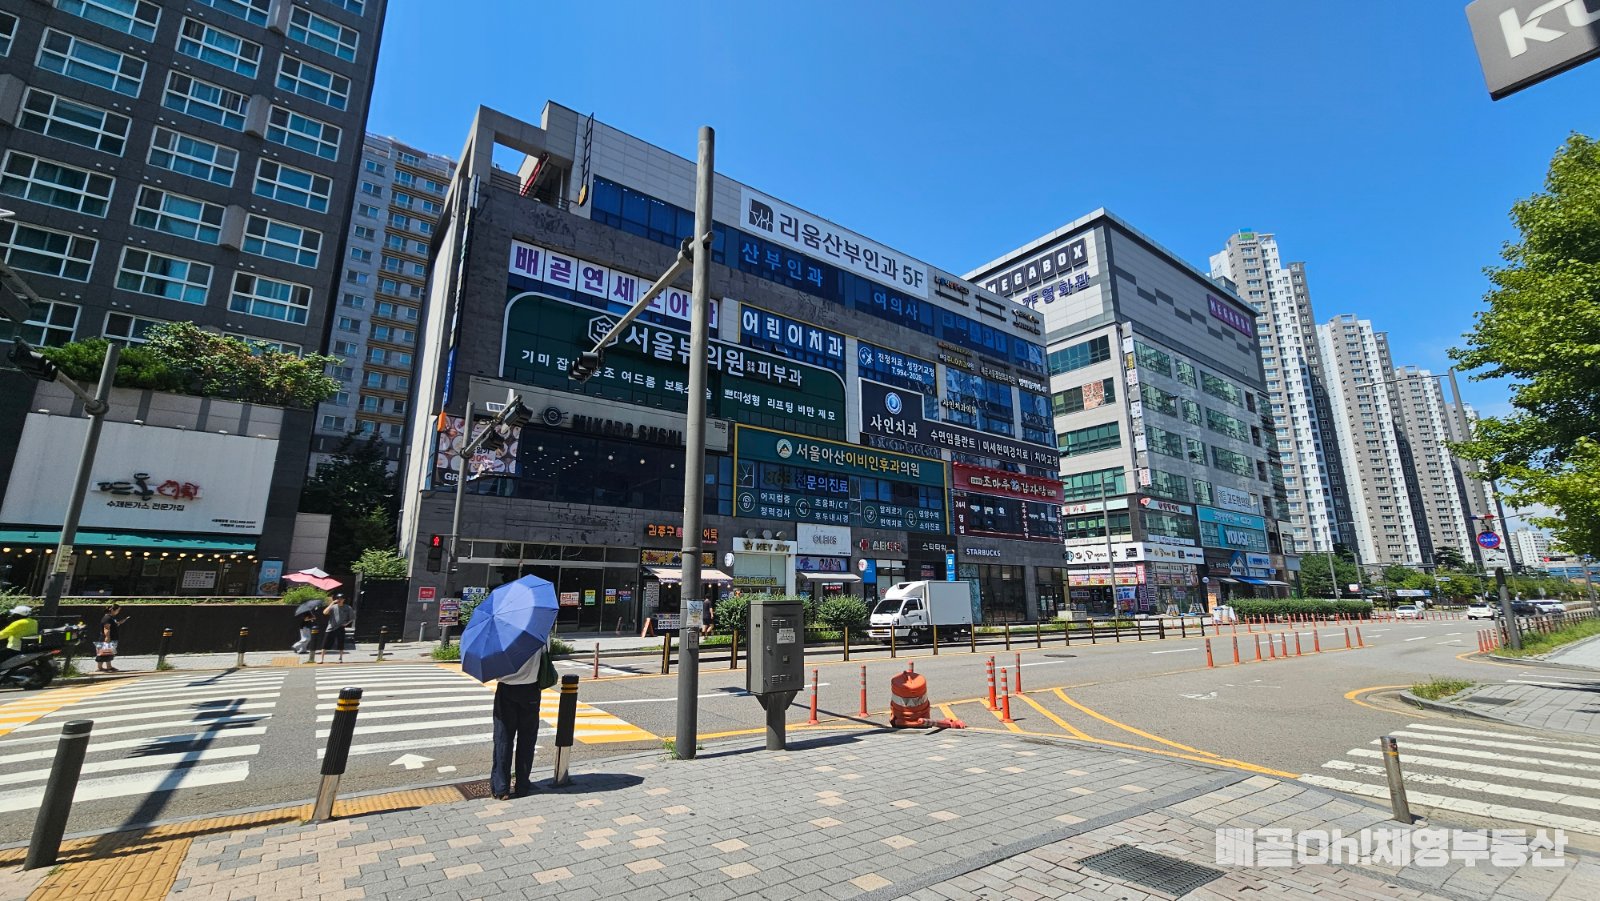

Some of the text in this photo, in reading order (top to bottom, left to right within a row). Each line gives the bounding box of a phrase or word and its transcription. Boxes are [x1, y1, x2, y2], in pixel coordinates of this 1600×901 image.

[742, 241, 823, 287] 산부인과
[779, 212, 898, 280] 리움산부인과
[902, 264, 924, 288] 5F
[515, 245, 716, 324] 배곧연세아
[987, 244, 1083, 293] MEGABOX
[873, 291, 918, 321] 여의사
[742, 310, 843, 357] 어린이치과
[522, 350, 550, 367] 기미
[621, 371, 656, 388] 여드름
[724, 389, 760, 407] 쁘띠성형
[767, 398, 794, 413] 리프팅
[797, 404, 815, 418] 비만
[818, 409, 836, 421] 제모
[757, 361, 803, 387] 피부과
[572, 414, 683, 446] MIKADO SUSHI
[870, 414, 918, 439] 샤인치과
[930, 430, 976, 450] 수면임플란트
[796, 443, 920, 478] 서울아산이비인후과의원
[796, 474, 848, 493] 전문의진료
[982, 476, 1010, 490] 조마루
[1021, 483, 1046, 497] 감자탕
[106, 500, 150, 510] 수제돈가스
[760, 507, 791, 518] 청력검사
[756, 542, 790, 552] HEY JOY
[966, 548, 1001, 557] STARBUCKS
